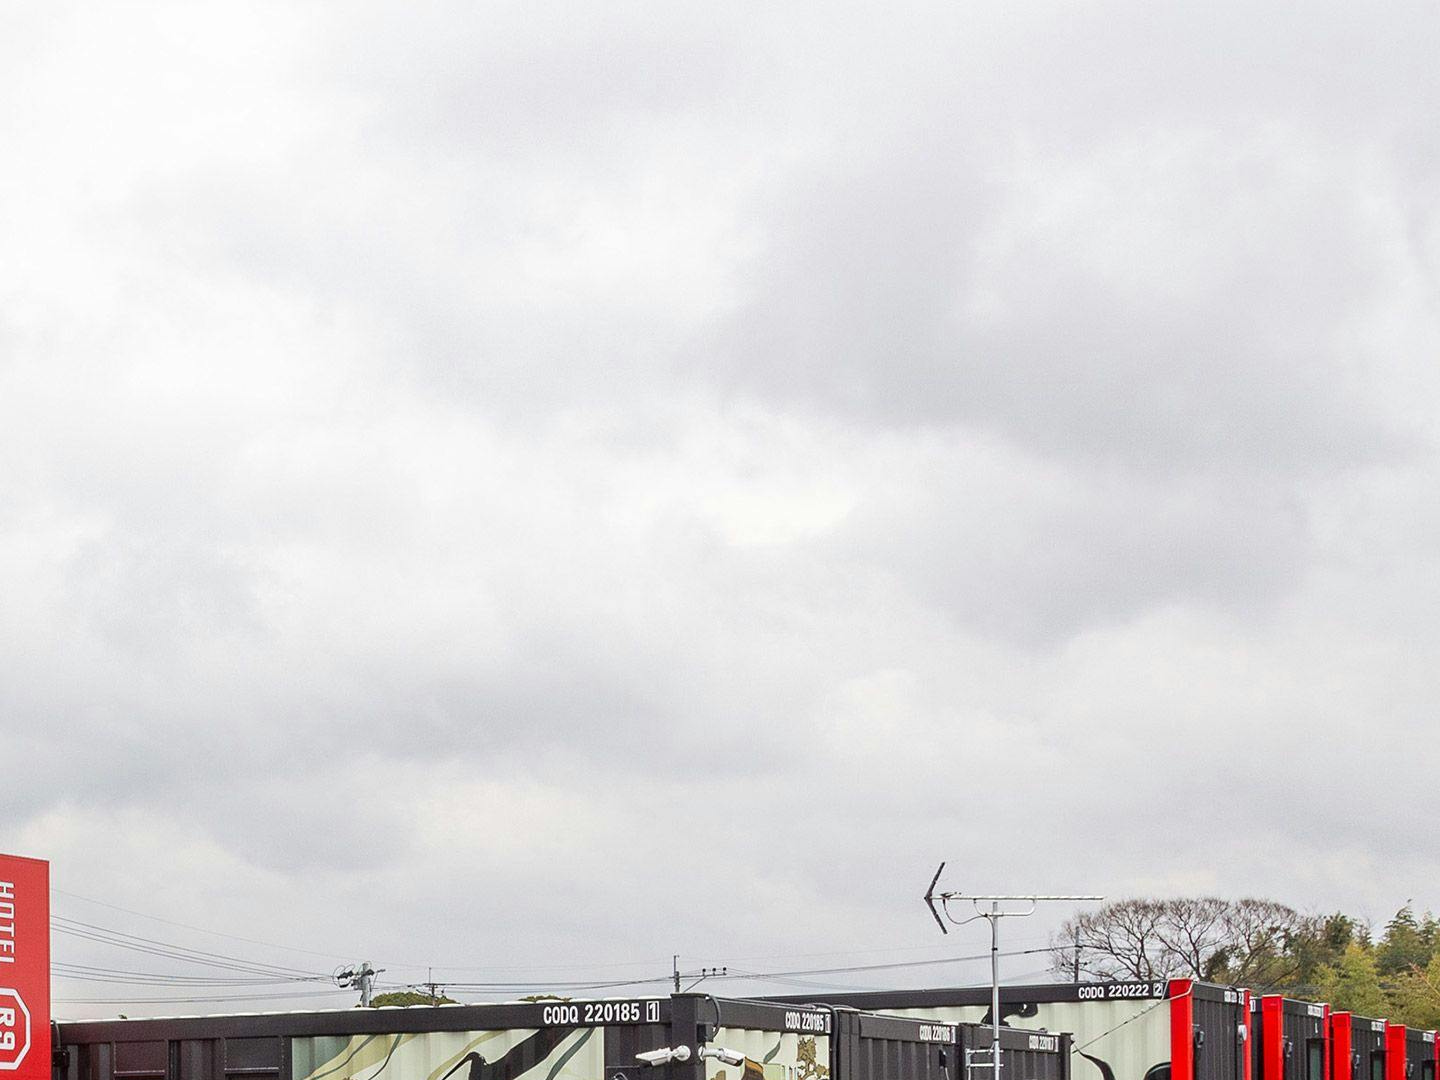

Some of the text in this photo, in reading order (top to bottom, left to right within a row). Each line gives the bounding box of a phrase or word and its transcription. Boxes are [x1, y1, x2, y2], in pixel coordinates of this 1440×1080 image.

[1078, 986, 1105, 998] CODQ
[1108, 983, 1150, 997] 220222
[543, 1005, 579, 1024] CODQ
[584, 1002, 640, 1022] 220185
[785, 1011, 801, 1030] CODQ
[802, 1012, 824, 1031] 220185
